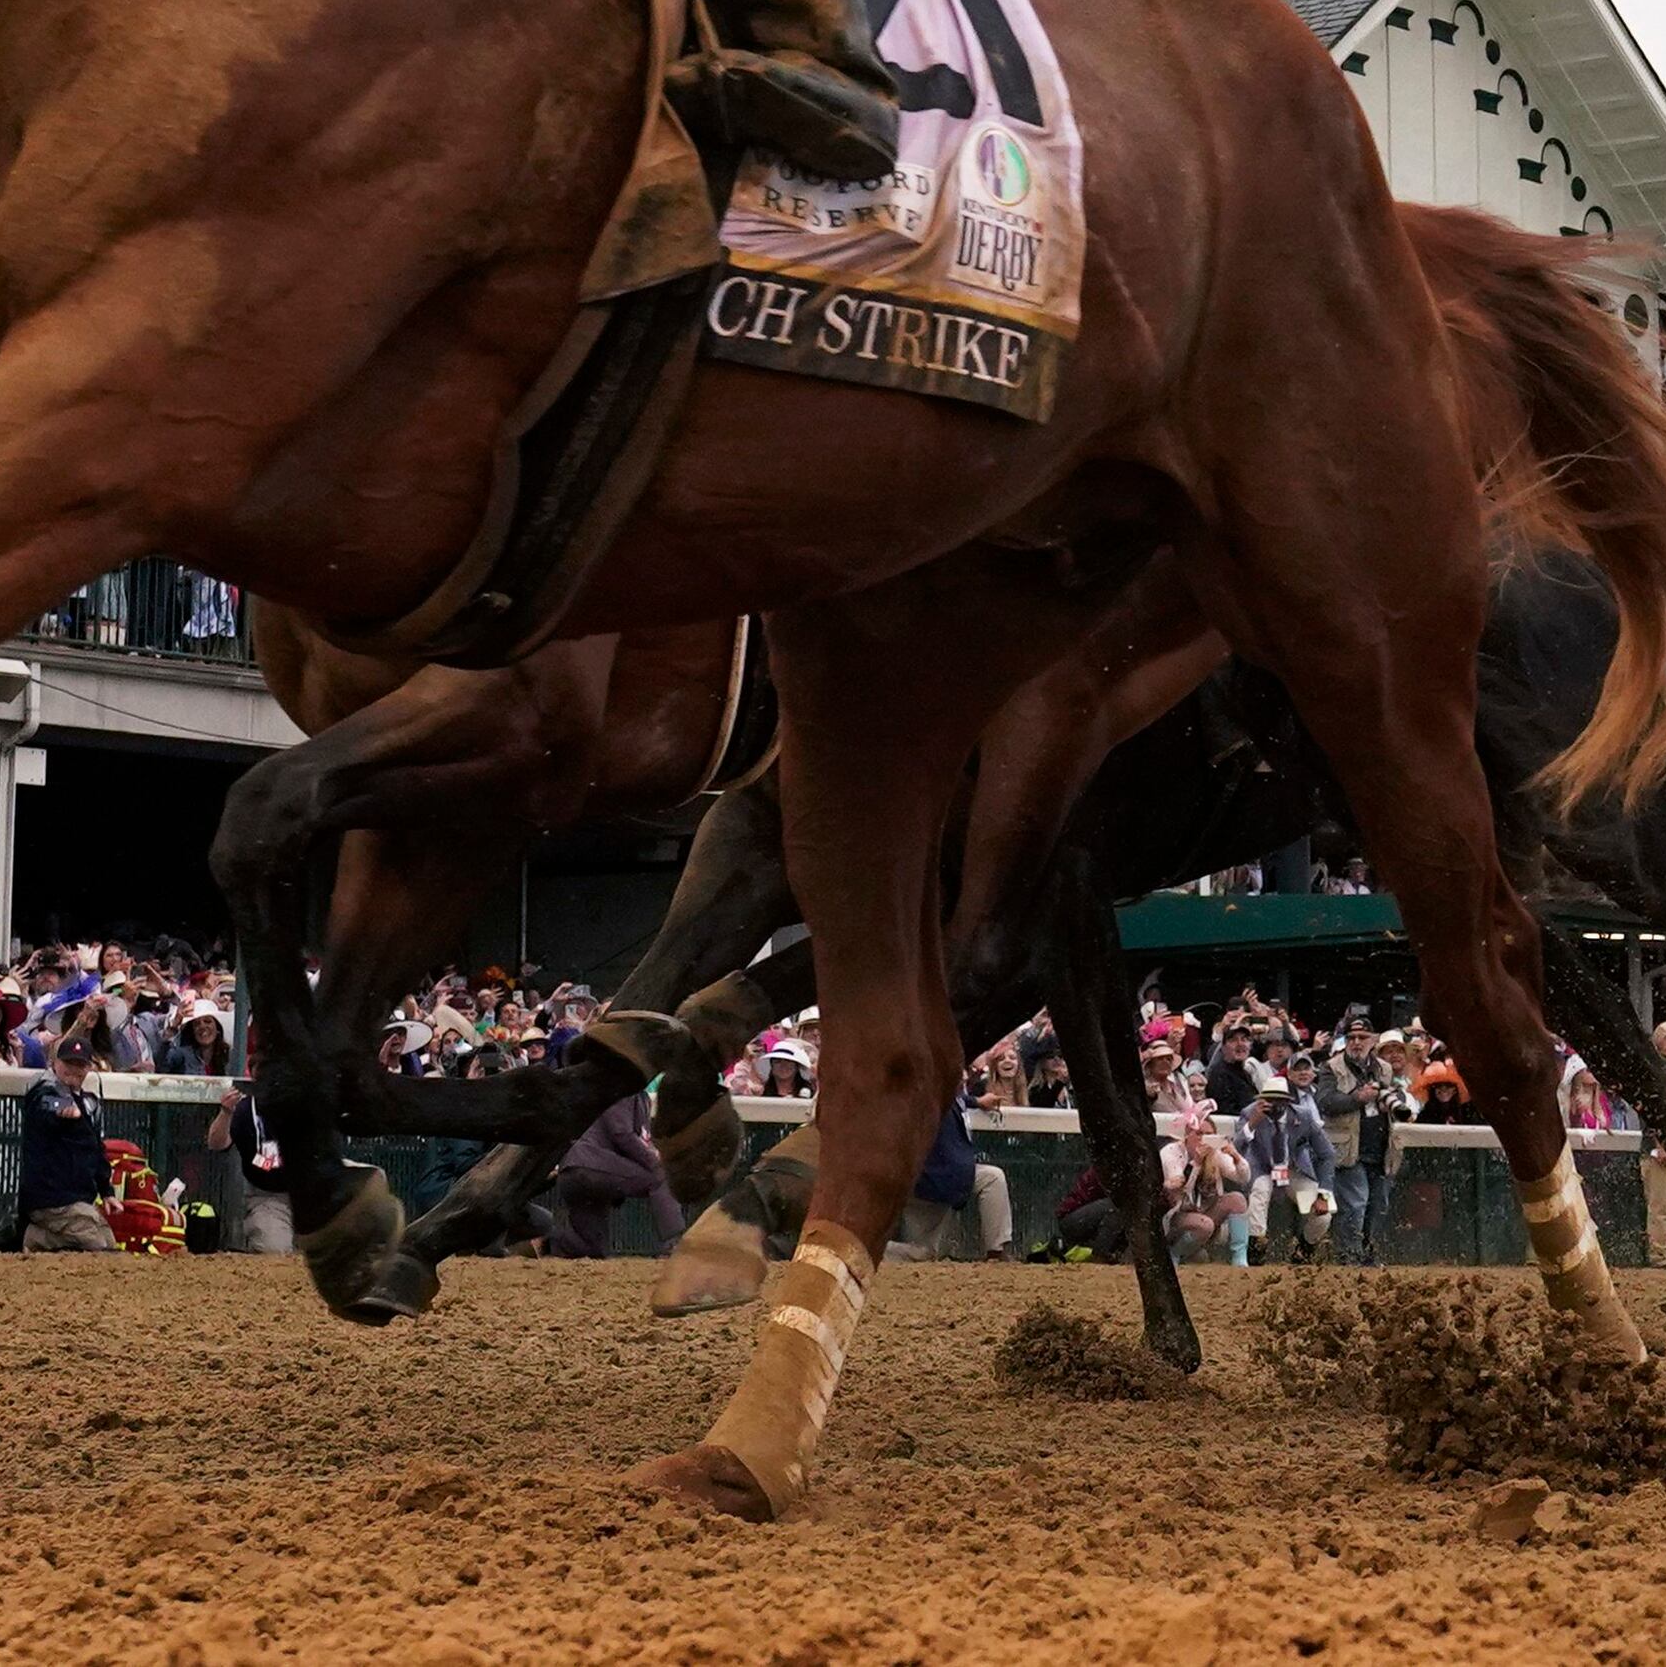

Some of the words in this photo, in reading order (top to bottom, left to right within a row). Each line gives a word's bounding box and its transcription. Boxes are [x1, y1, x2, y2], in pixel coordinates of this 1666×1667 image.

[760, 186, 923, 232] RESERVE
[960, 197, 1031, 229] KENTUCKY
[956, 214, 1043, 291] DERBY
[817, 292, 1030, 389] STRIKE
